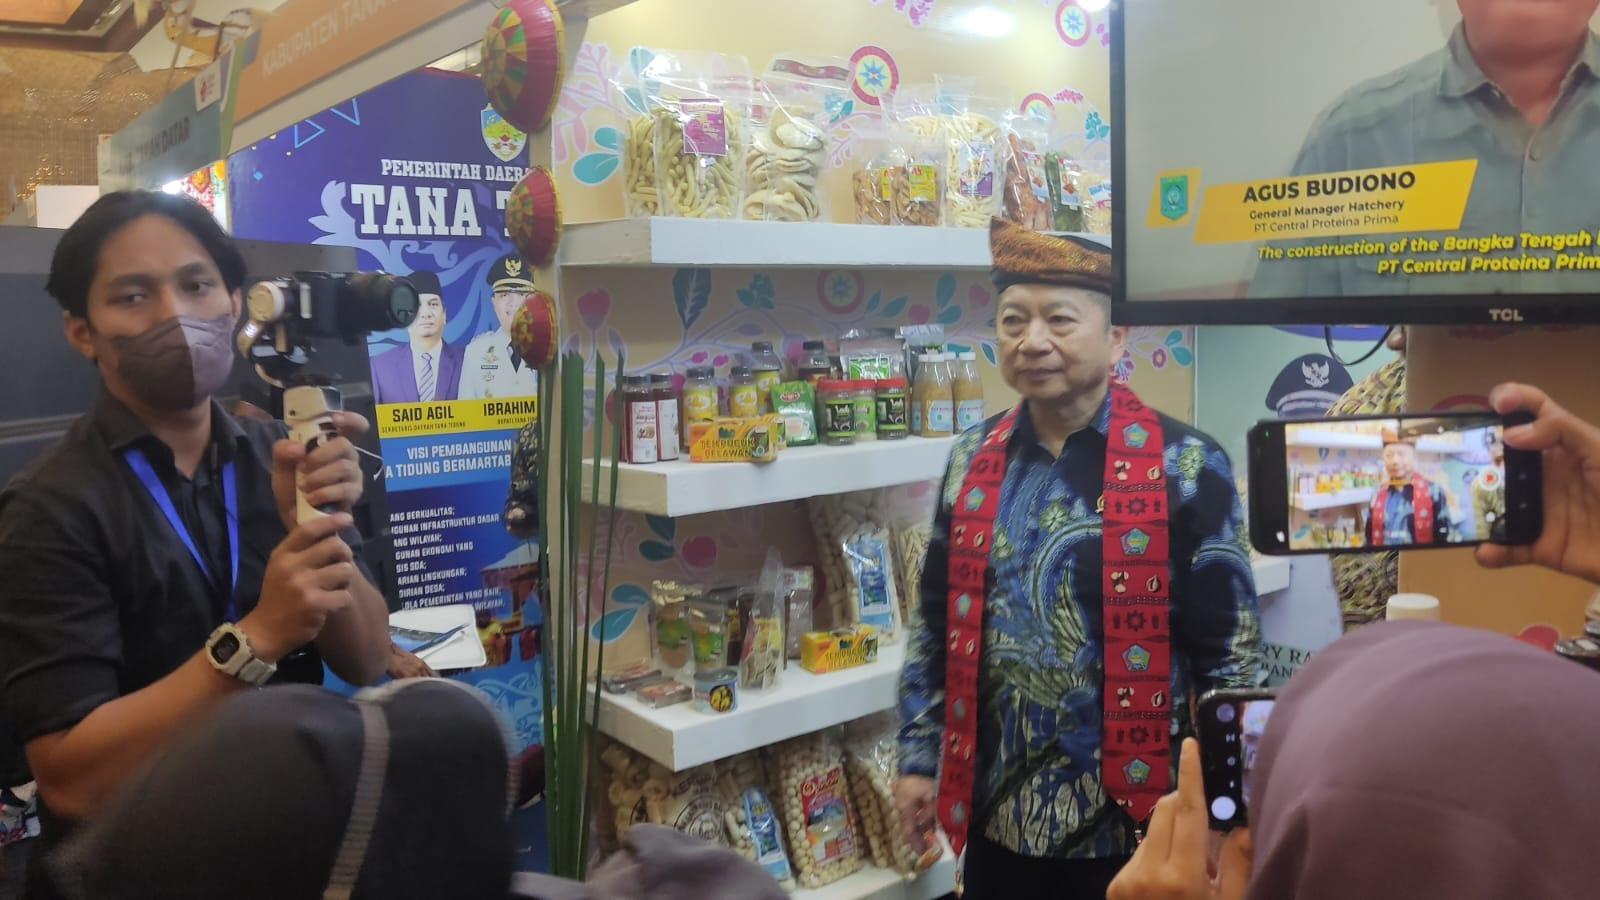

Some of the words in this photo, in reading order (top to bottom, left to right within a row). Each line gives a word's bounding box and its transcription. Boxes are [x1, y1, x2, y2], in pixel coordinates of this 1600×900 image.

[381, 158, 482, 181] PEMERINTAH
[485, 165, 530, 183] DAER
[1243, 181, 1300, 203] AGUS
[1306, 171, 1416, 197] BUDIONO
[350, 184, 482, 236] TANA
[1249, 206, 1292, 220] General
[1294, 203, 1345, 217] Manager
[1348, 199, 1405, 212] Hatchery
[1254, 223, 1267, 233] PT
[1269, 219, 1309, 233] Central
[1312, 216, 1360, 228] Proteina
[1363, 213, 1400, 225] Prima
[1258, 246, 1284, 260] The
[1286, 241, 1386, 259] construction
[1389, 237, 1408, 253] of
[1410, 237, 1440, 253] the
[1443, 233, 1515, 253] Bangka
[1519, 229, 1593, 251] Tengah
[1377, 258, 1400, 275] PT
[1402, 255, 1468, 274] Central
[1470, 253, 1551, 272] Proteina
[1488, 308, 1524, 321] TCL
[392, 407, 423, 422] SAID
[426, 405, 455, 420] AGIL
[483, 400, 535, 416] IBRAHIM
[407, 446, 429, 460] VISI
[431, 439, 512, 458] PEMBANGUNAN
[385, 465, 394, 479] A
[395, 460, 441, 477] TIDUNG
[443, 454, 512, 473] BERMARTAB
[420, 516, 476, 531] INFRASTRUKTUR
[477, 513, 500, 524] DASAR
[421, 544, 455, 557] EKONOMI
[455, 541, 474, 552] YANG
